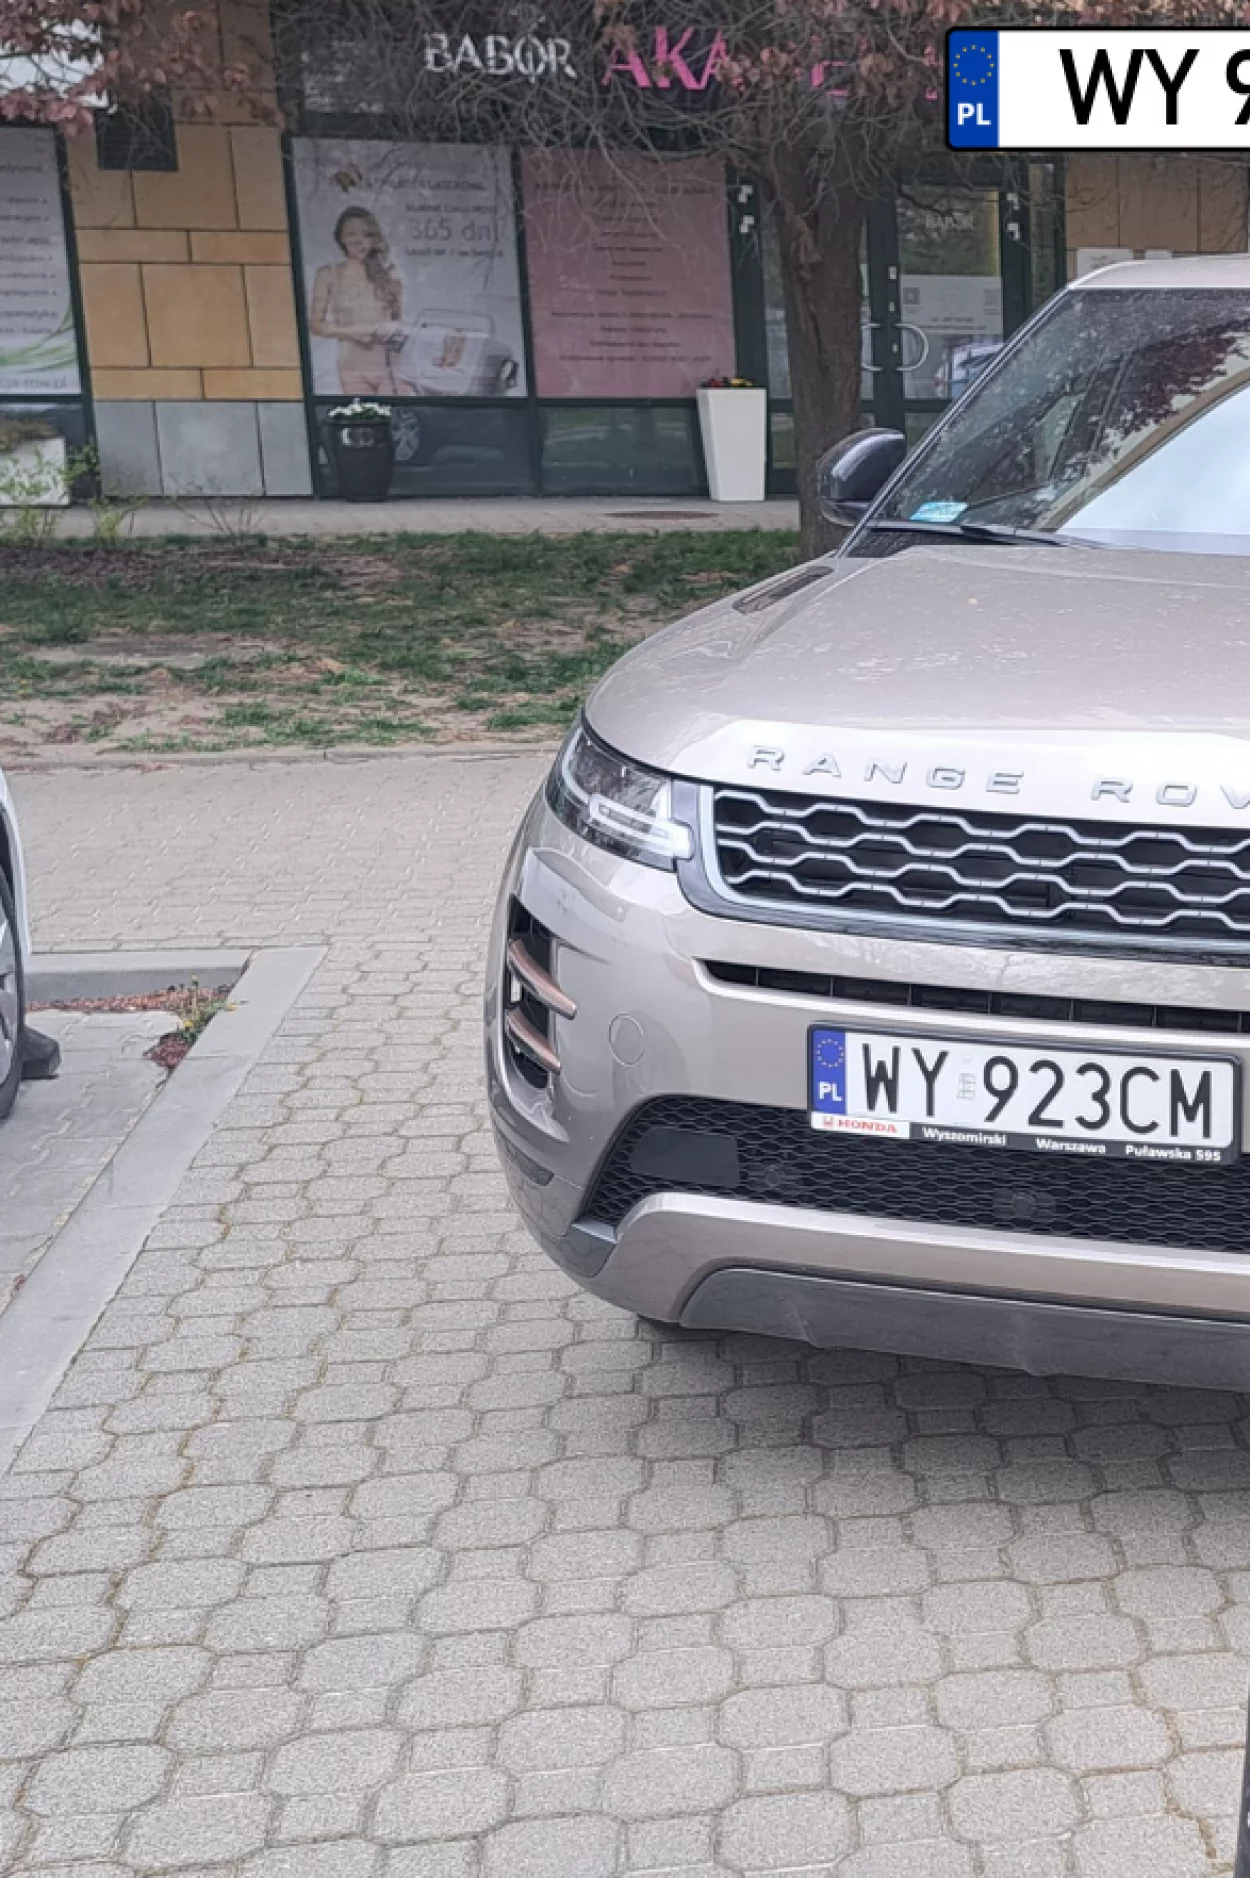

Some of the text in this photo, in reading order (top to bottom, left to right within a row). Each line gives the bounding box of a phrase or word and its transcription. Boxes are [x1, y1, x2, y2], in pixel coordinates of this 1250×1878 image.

[423, 33, 578, 81] BABOR
[746, 744, 1024, 795] RANGE
[819, 1080, 842, 1102] PL
[862, 1043, 1212, 1139] WY 923CM
[837, 1119, 898, 1134] HONDA
[922, 1126, 1007, 1147] Wyszomirski
[1036, 1137, 1107, 1155] Warszawa
[1195, 1148, 1221, 1162] 595
